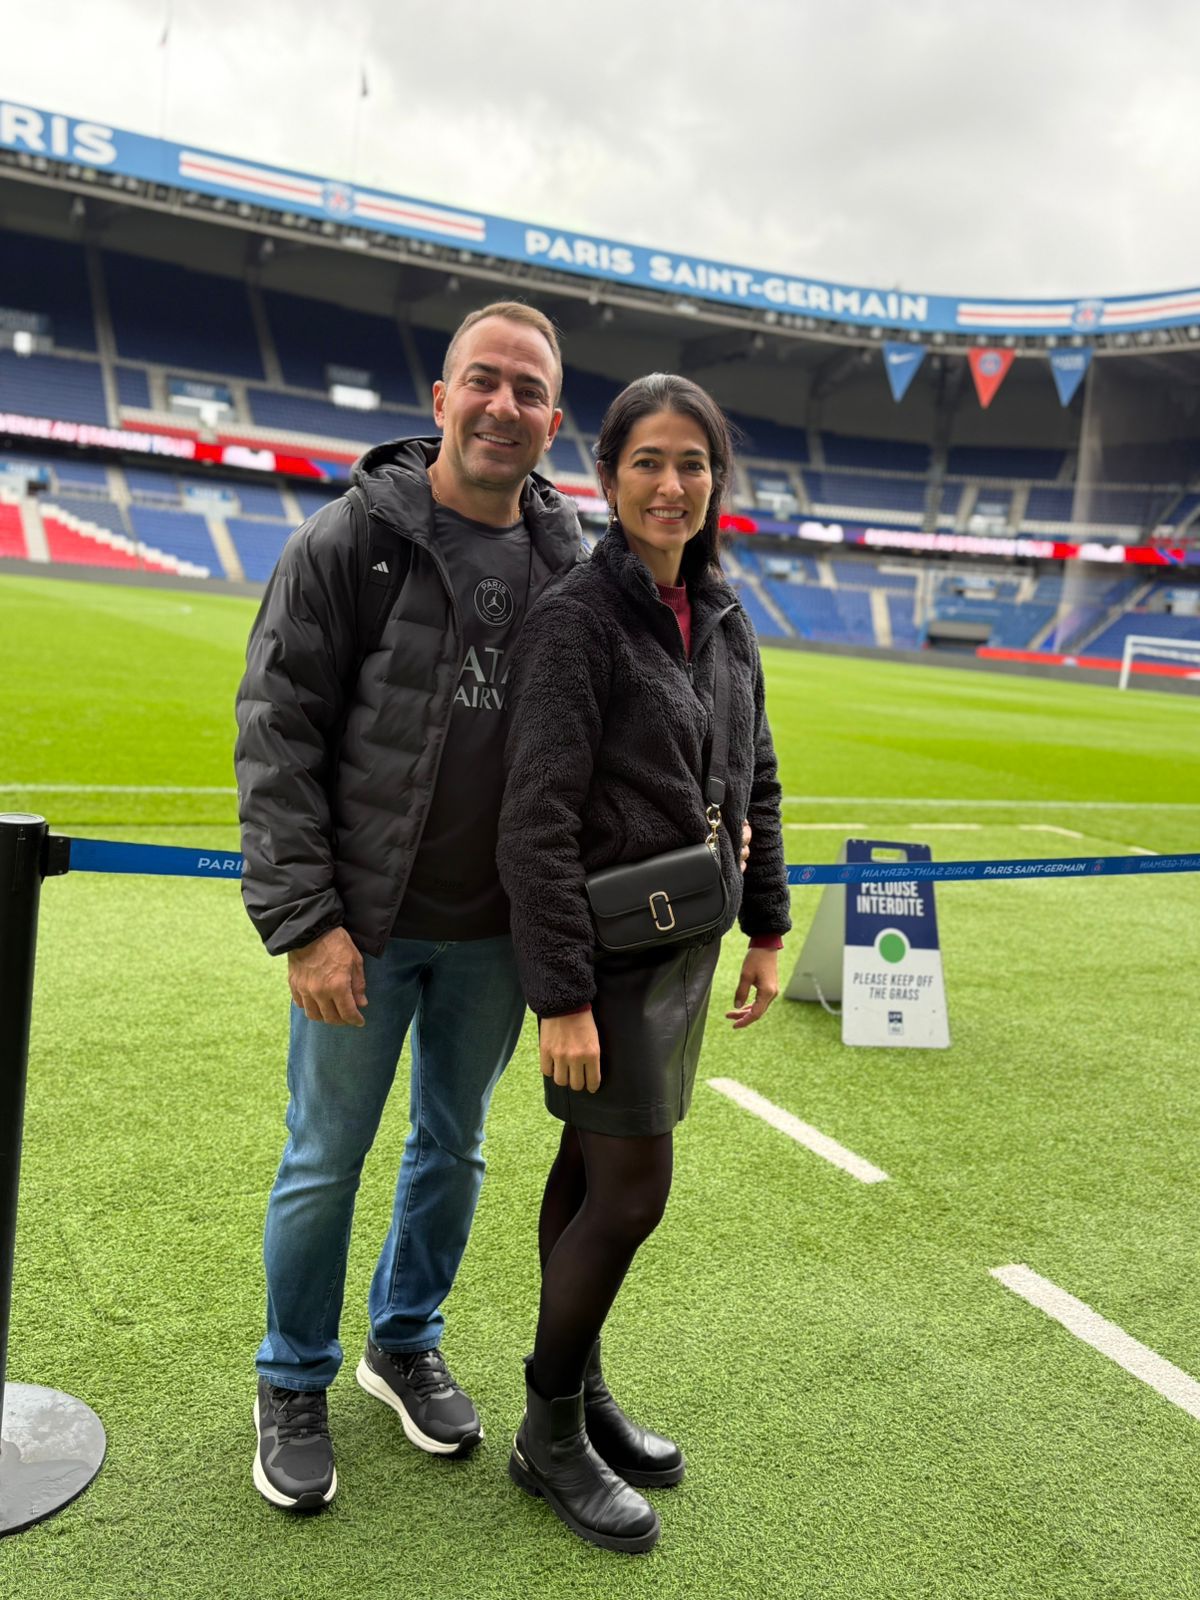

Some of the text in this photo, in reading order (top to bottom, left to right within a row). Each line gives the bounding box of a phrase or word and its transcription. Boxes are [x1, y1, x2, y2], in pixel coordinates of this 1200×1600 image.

[0, 103, 117, 165] RIS
[525, 229, 928, 322] PARIS SAINT-GERMAIN
[480, 581, 507, 594] PARIS
[198, 857, 245, 873] PARI
[984, 863, 1086, 875] PARIS SAINT-GERMAIN
[856, 895, 924, 917] INTERDITE
[853, 972, 934, 987] PLEASE KEEP OFF
[870, 987, 920, 1001] THE GRASS
